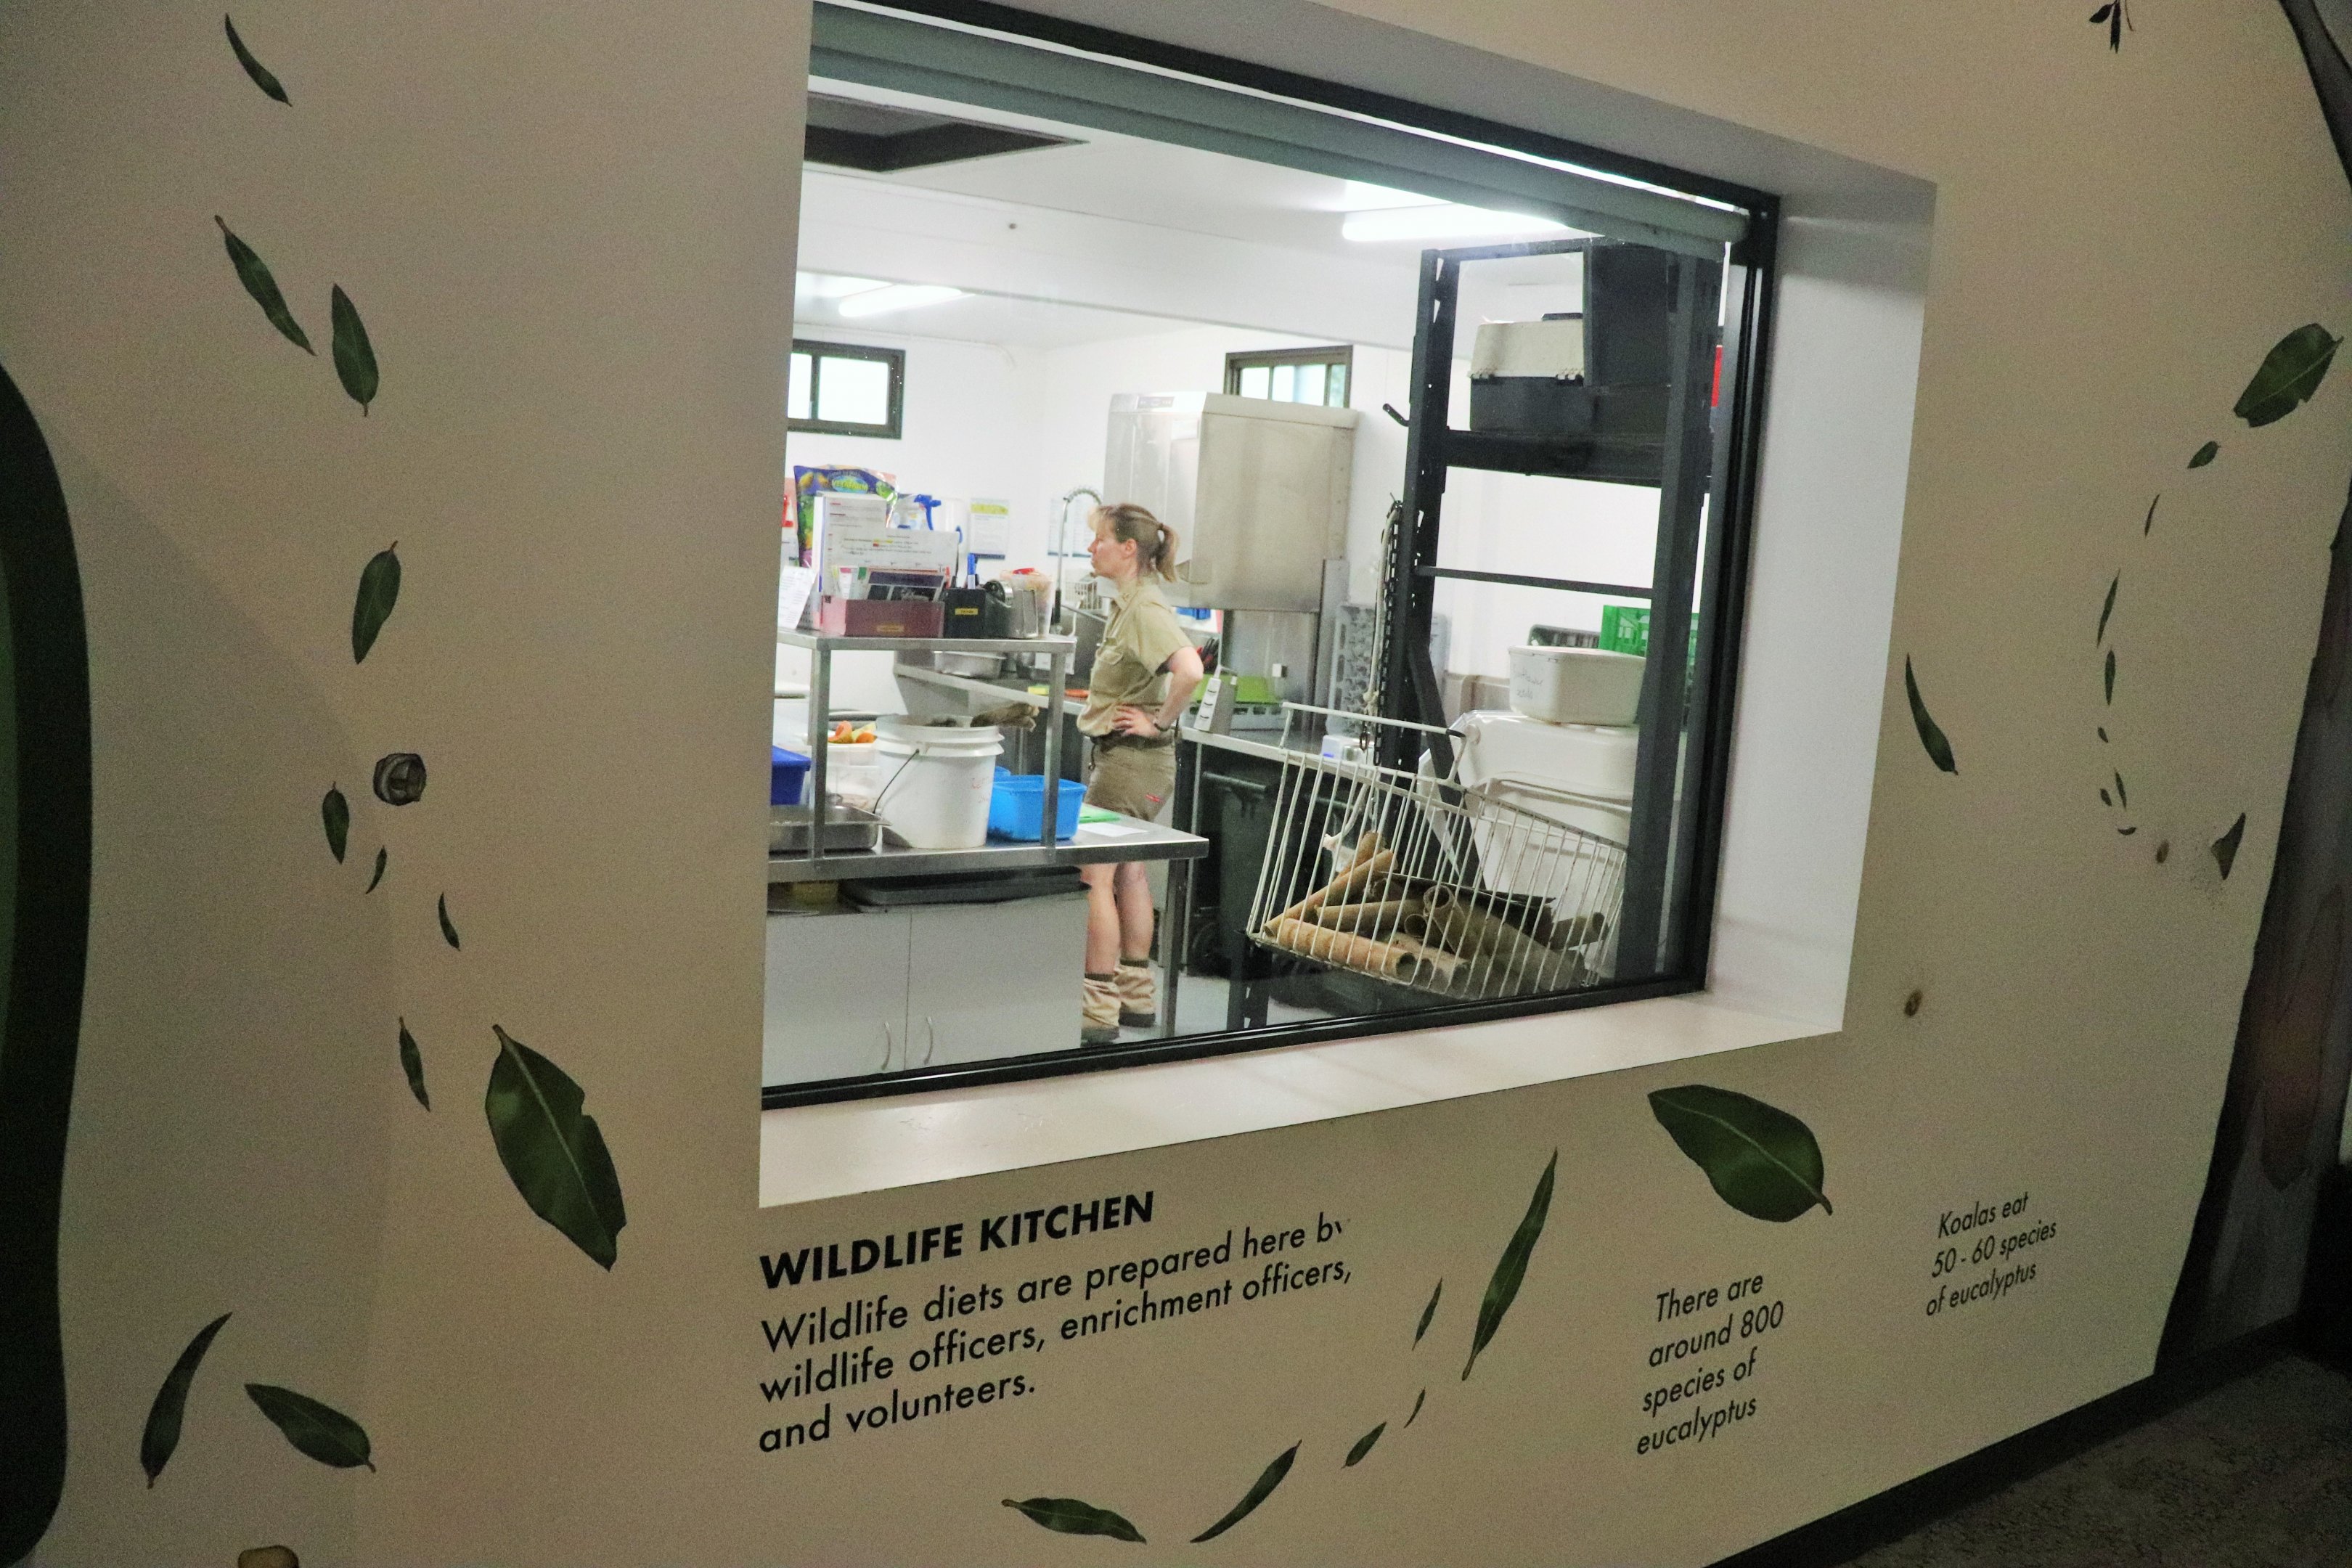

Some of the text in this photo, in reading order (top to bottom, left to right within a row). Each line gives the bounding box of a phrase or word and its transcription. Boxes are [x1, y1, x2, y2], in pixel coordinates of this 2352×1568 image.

[759, 1190, 1154, 1290] WILDLIFE KITCHEN
[1931, 1247, 1957, 1278] 50
[1971, 1235, 1996, 1265] 60
[1999, 1220, 2057, 1260] species
[1937, 1191, 2029, 1239] Koalas eat
[760, 1294, 909, 1353] Wildlife
[923, 1283, 1004, 1322] diets
[1017, 1274, 1072, 1304] are
[1085, 1229, 1233, 1301] prepared
[1242, 1225, 1306, 1259] here
[1656, 1275, 1764, 1323] There are
[1926, 1260, 2036, 1317] of eucalyptus
[759, 1260, 1352, 1403] wildlife officers, enrichment officers,
[1648, 1299, 1784, 1368] around 800
[759, 1374, 1035, 1453] and volunteers.
[1642, 1346, 1758, 1418] species of
[1636, 1397, 1757, 1455] eucalyptus
